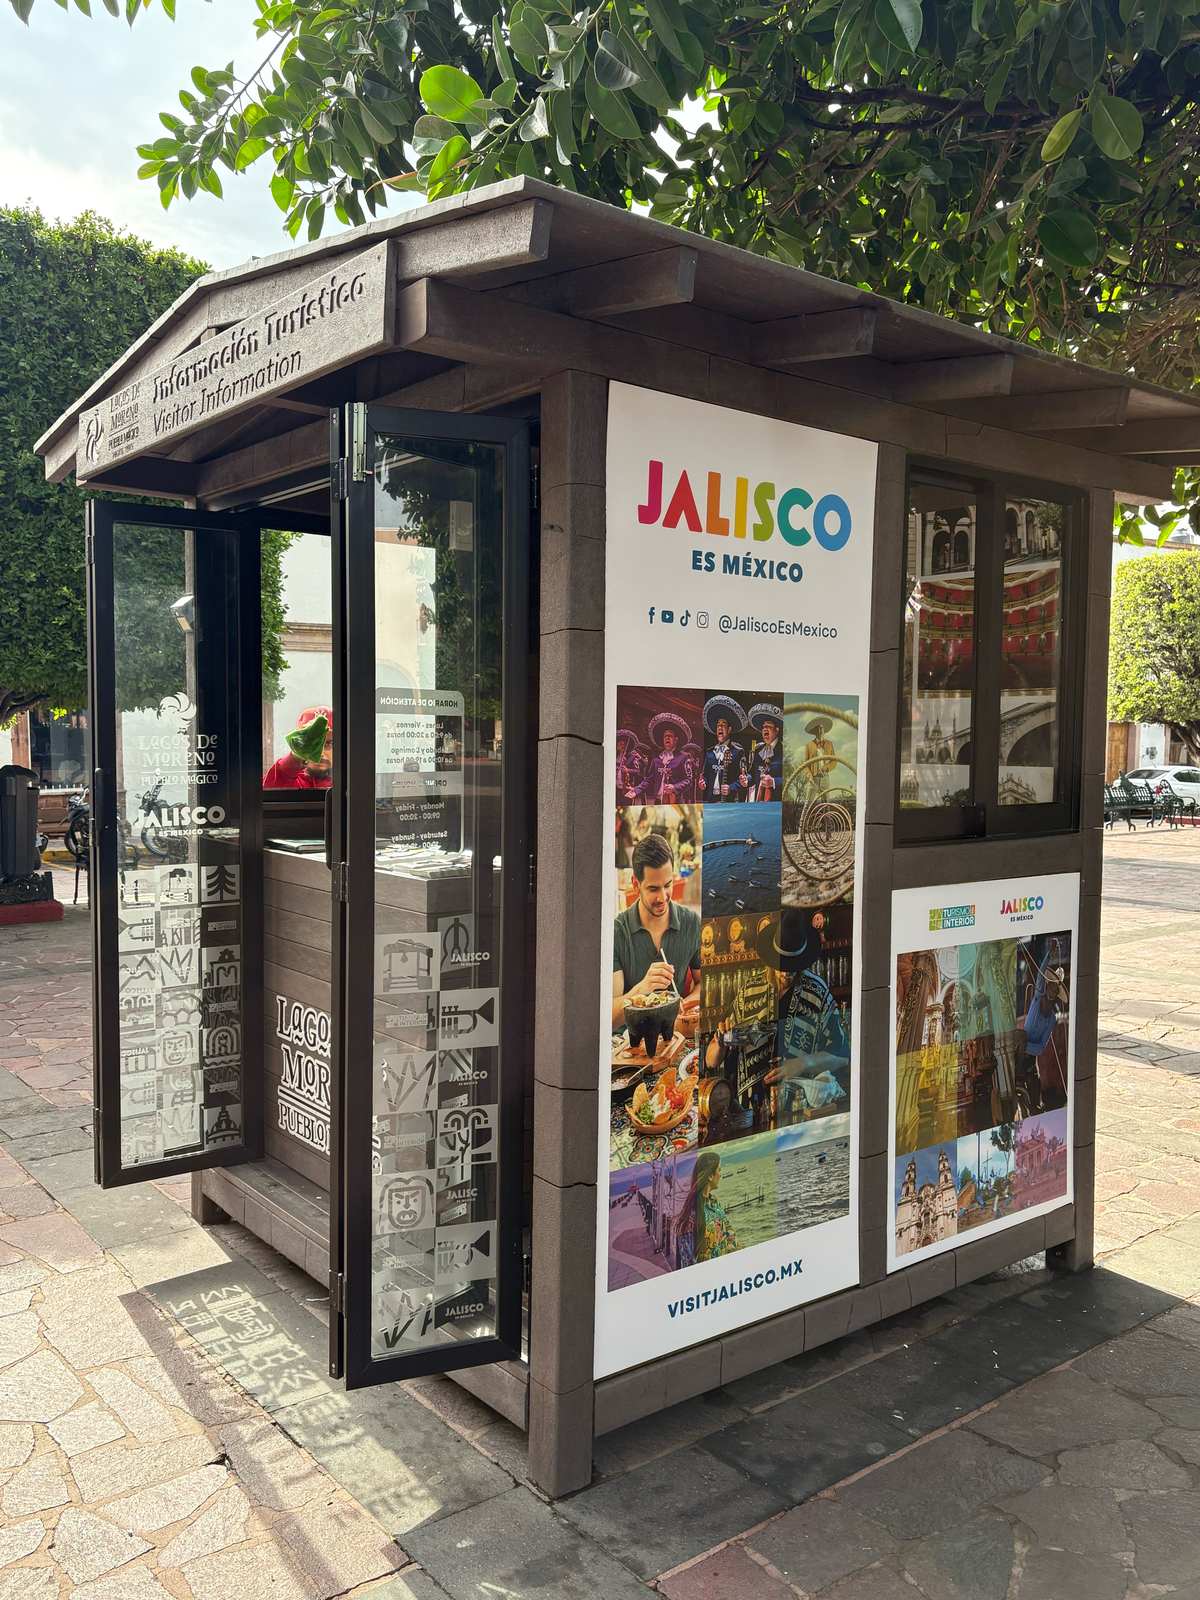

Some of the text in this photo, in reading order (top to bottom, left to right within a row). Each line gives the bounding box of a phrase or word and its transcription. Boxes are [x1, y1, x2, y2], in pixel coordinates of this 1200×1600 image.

[153, 328, 259, 404] Información
[153, 350, 301, 437] Visitor Information
[638, 460, 852, 552] JALISCO
[691, 550, 804, 583] ES MÉXICO
[718, 614, 839, 639] @JaliscoEsMexico
[943, 916, 975, 928] INTERIOR
[1000, 896, 1044, 914] JALISCO
[450, 951, 491, 962] JALISCO
[276, 995, 331, 1057] LAGO
[281, 1043, 331, 1107] MOR
[444, 1302, 485, 1317] JALISCO
[667, 1259, 804, 1319] VISITJALISCO.MX
